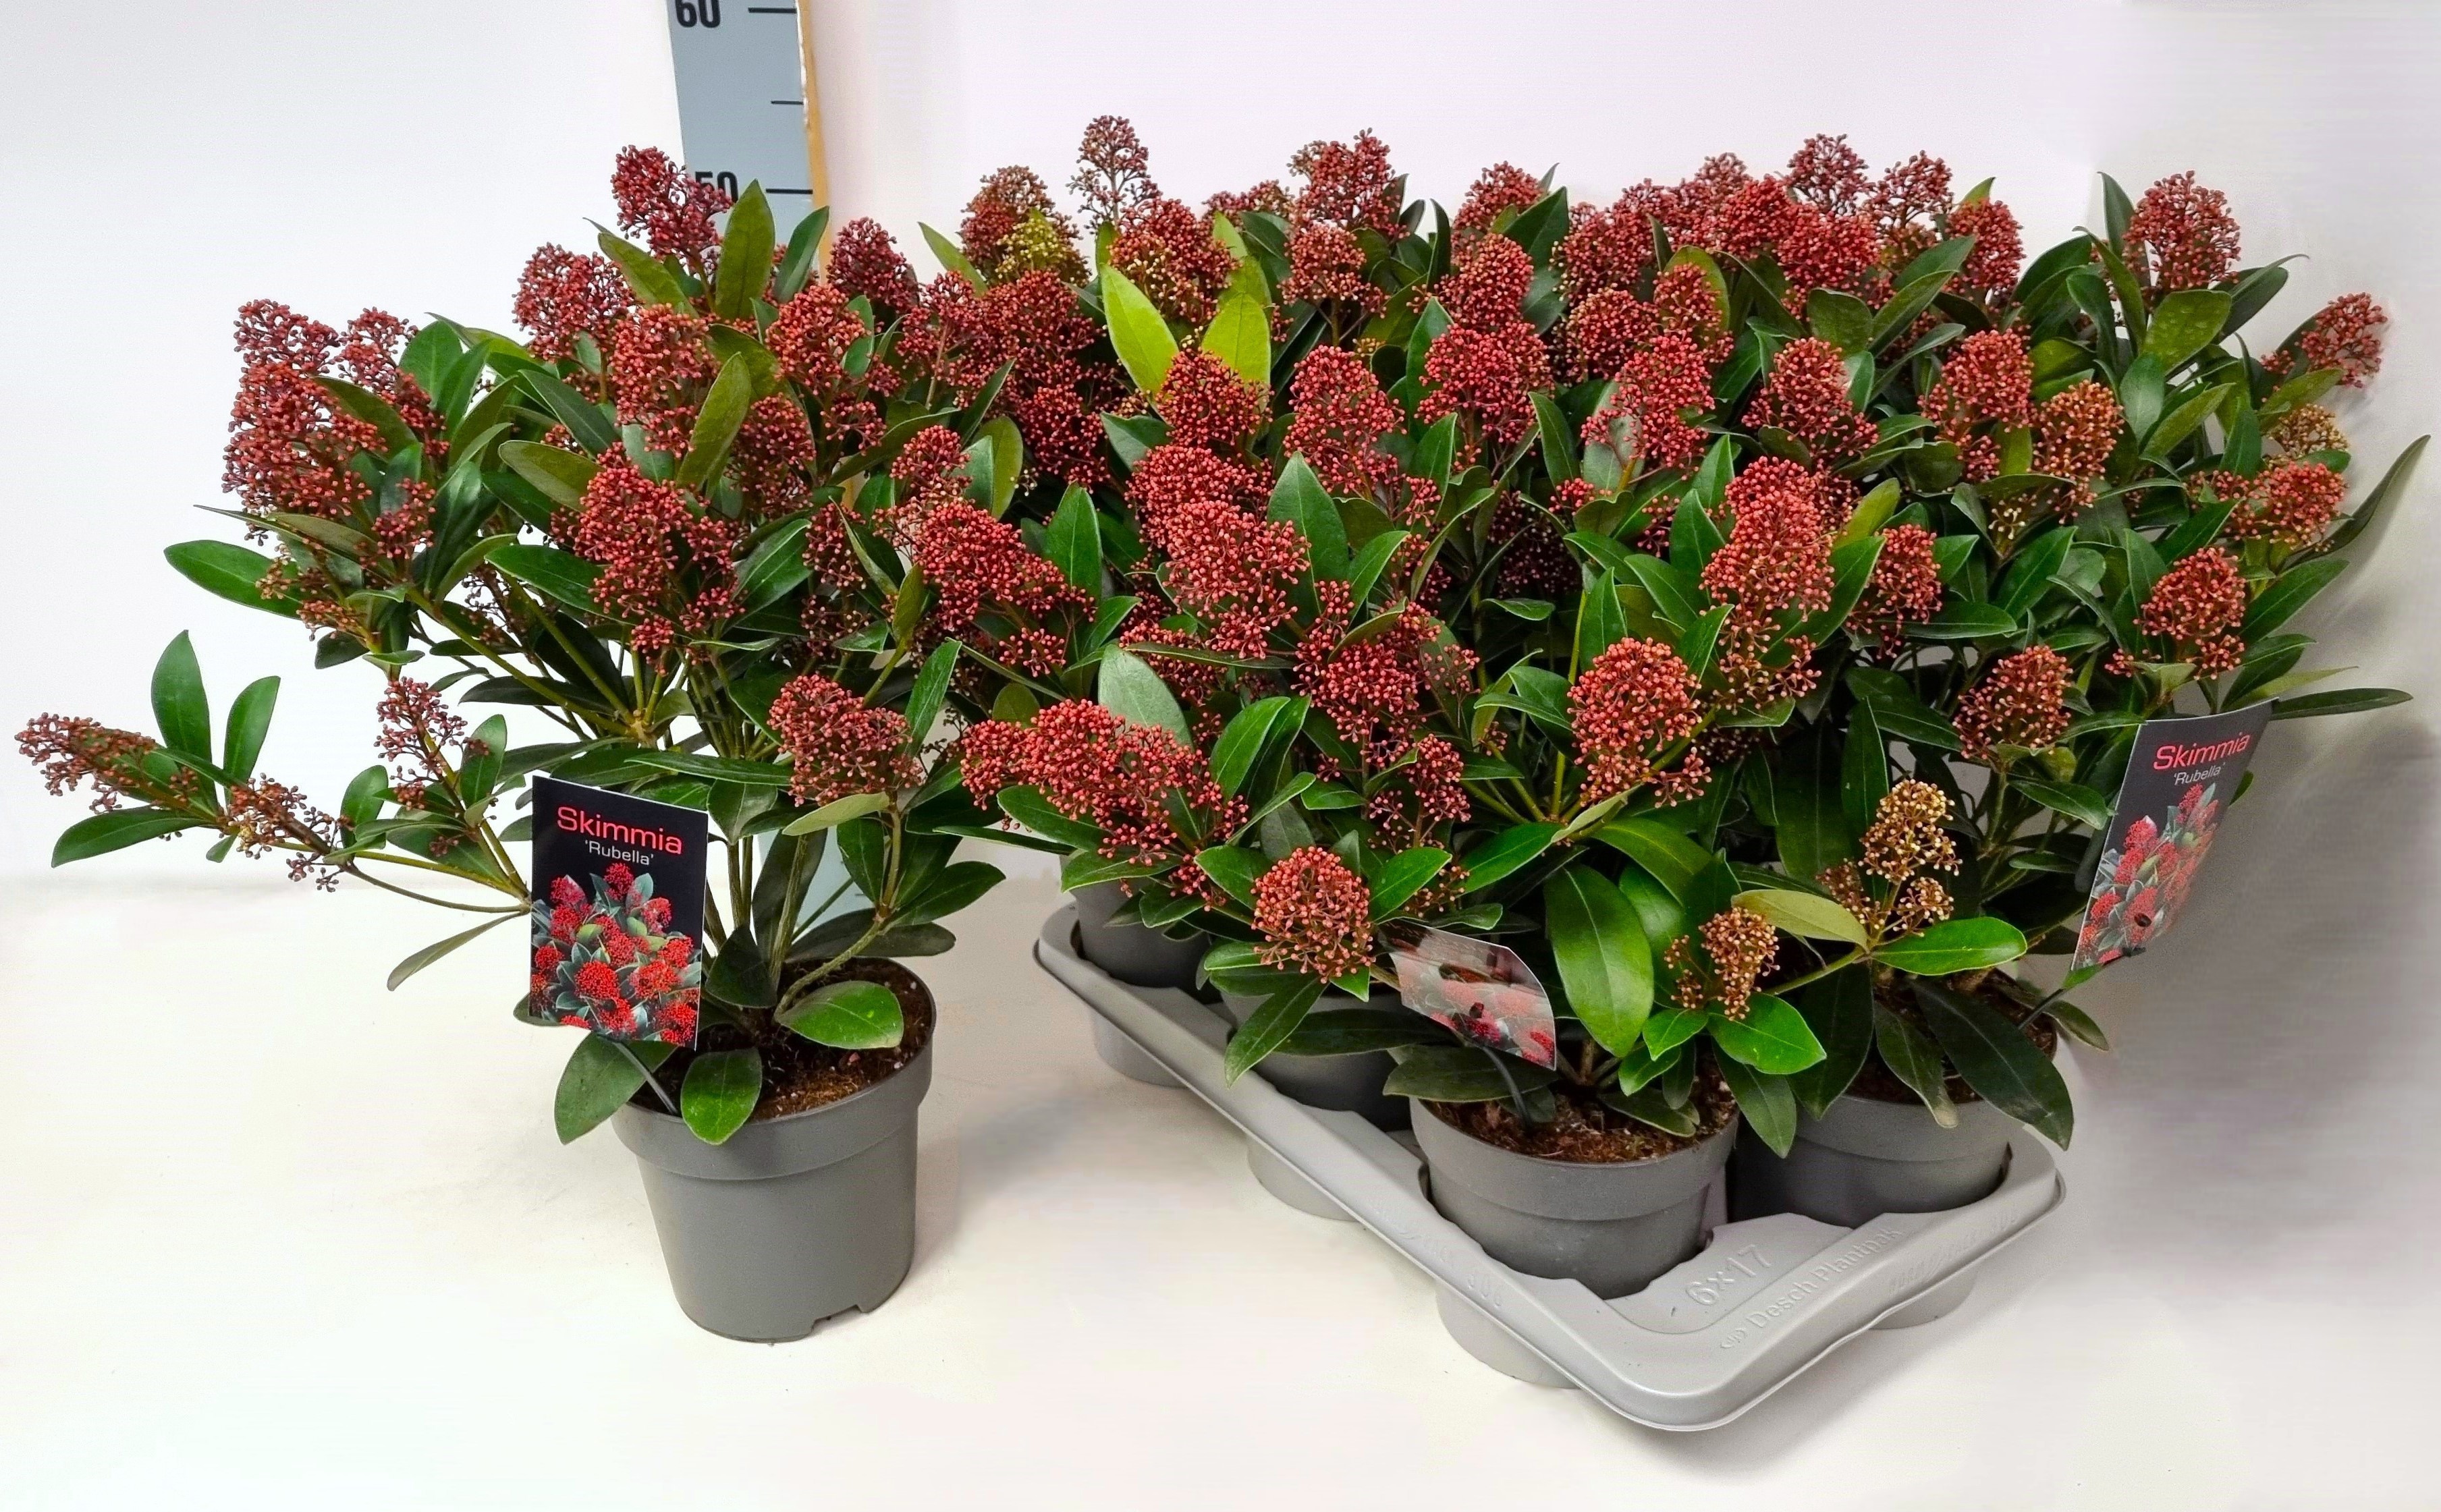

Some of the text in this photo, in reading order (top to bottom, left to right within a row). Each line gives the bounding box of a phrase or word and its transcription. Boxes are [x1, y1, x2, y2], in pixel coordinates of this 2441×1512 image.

[676, 0, 721, 28] 60
[2154, 731, 2251, 771] Skimmia
[557, 806, 683, 854] Skimmia
[1747, 1281, 1819, 1328] Desch
[1810, 1227, 1902, 1282] Plantpak
